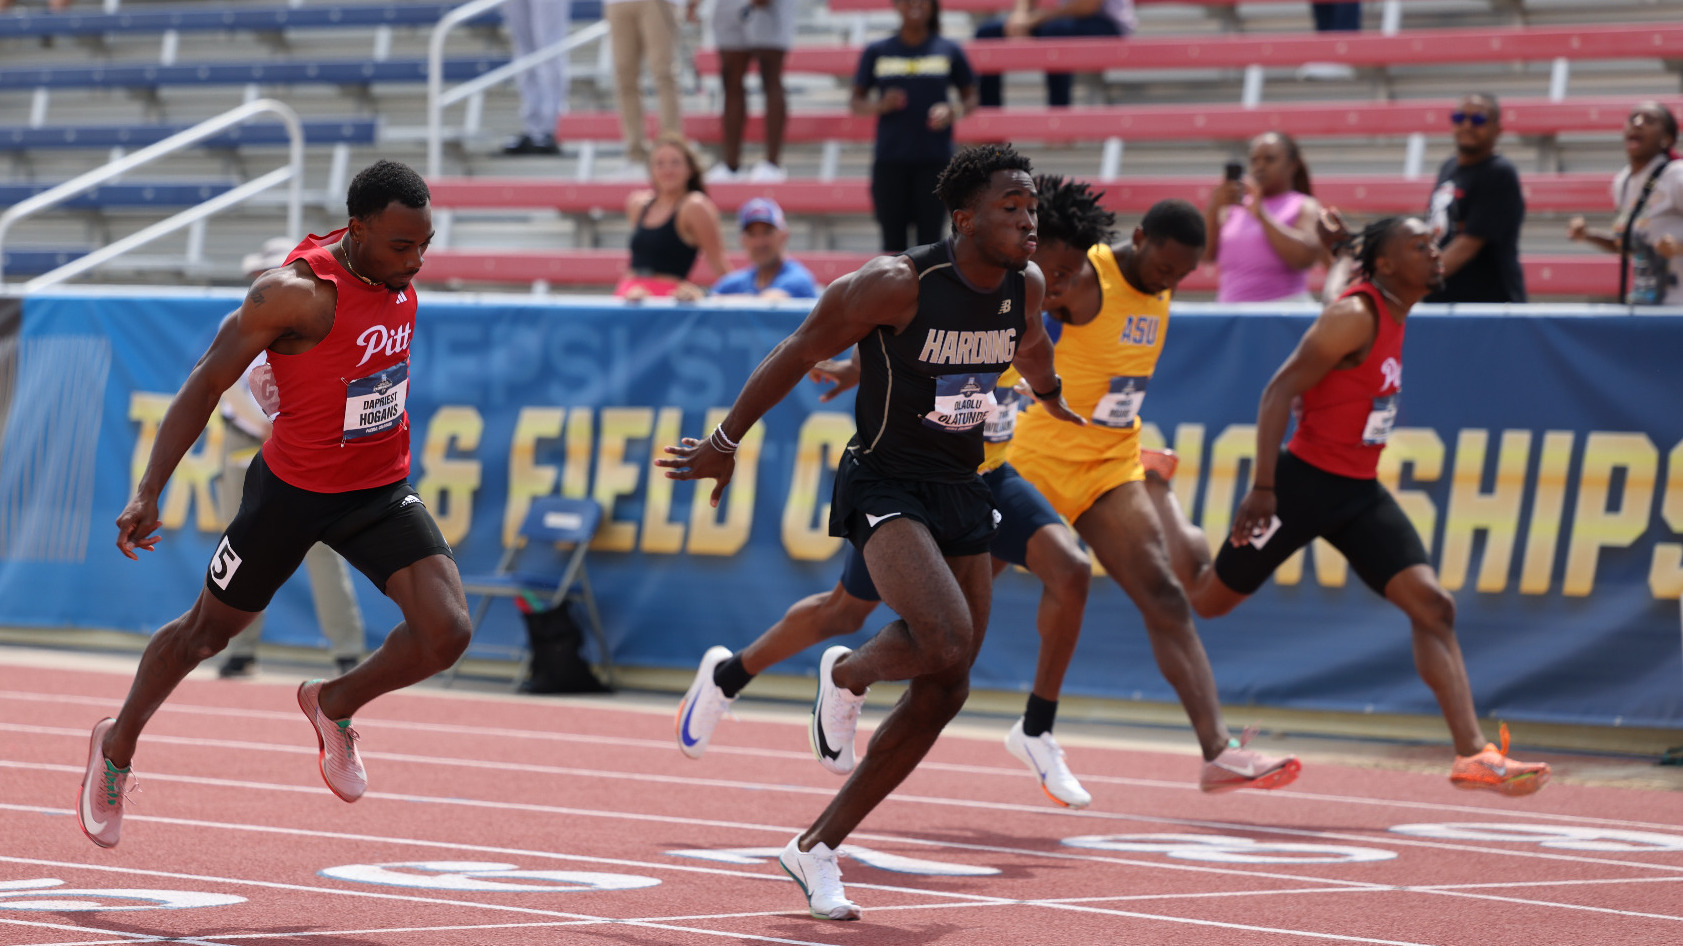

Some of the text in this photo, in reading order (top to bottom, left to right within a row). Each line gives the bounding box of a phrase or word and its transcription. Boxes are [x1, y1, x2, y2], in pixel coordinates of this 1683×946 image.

[356, 322, 411, 367] Pitt
[918, 328, 1017, 364] HARDING
[1117, 314, 1160, 347] ASU
[360, 403, 399, 427] HOGANS
[363, 391, 398, 411] DAPRIEST
[954, 400, 983, 411] OLAOLU
[938, 410, 990, 426] OLATUNDE
[502, 407, 767, 557] FIELD
[211, 543, 236, 580] 5
[1386, 820, 1683, 853] 9
[318, 860, 663, 893] 6
